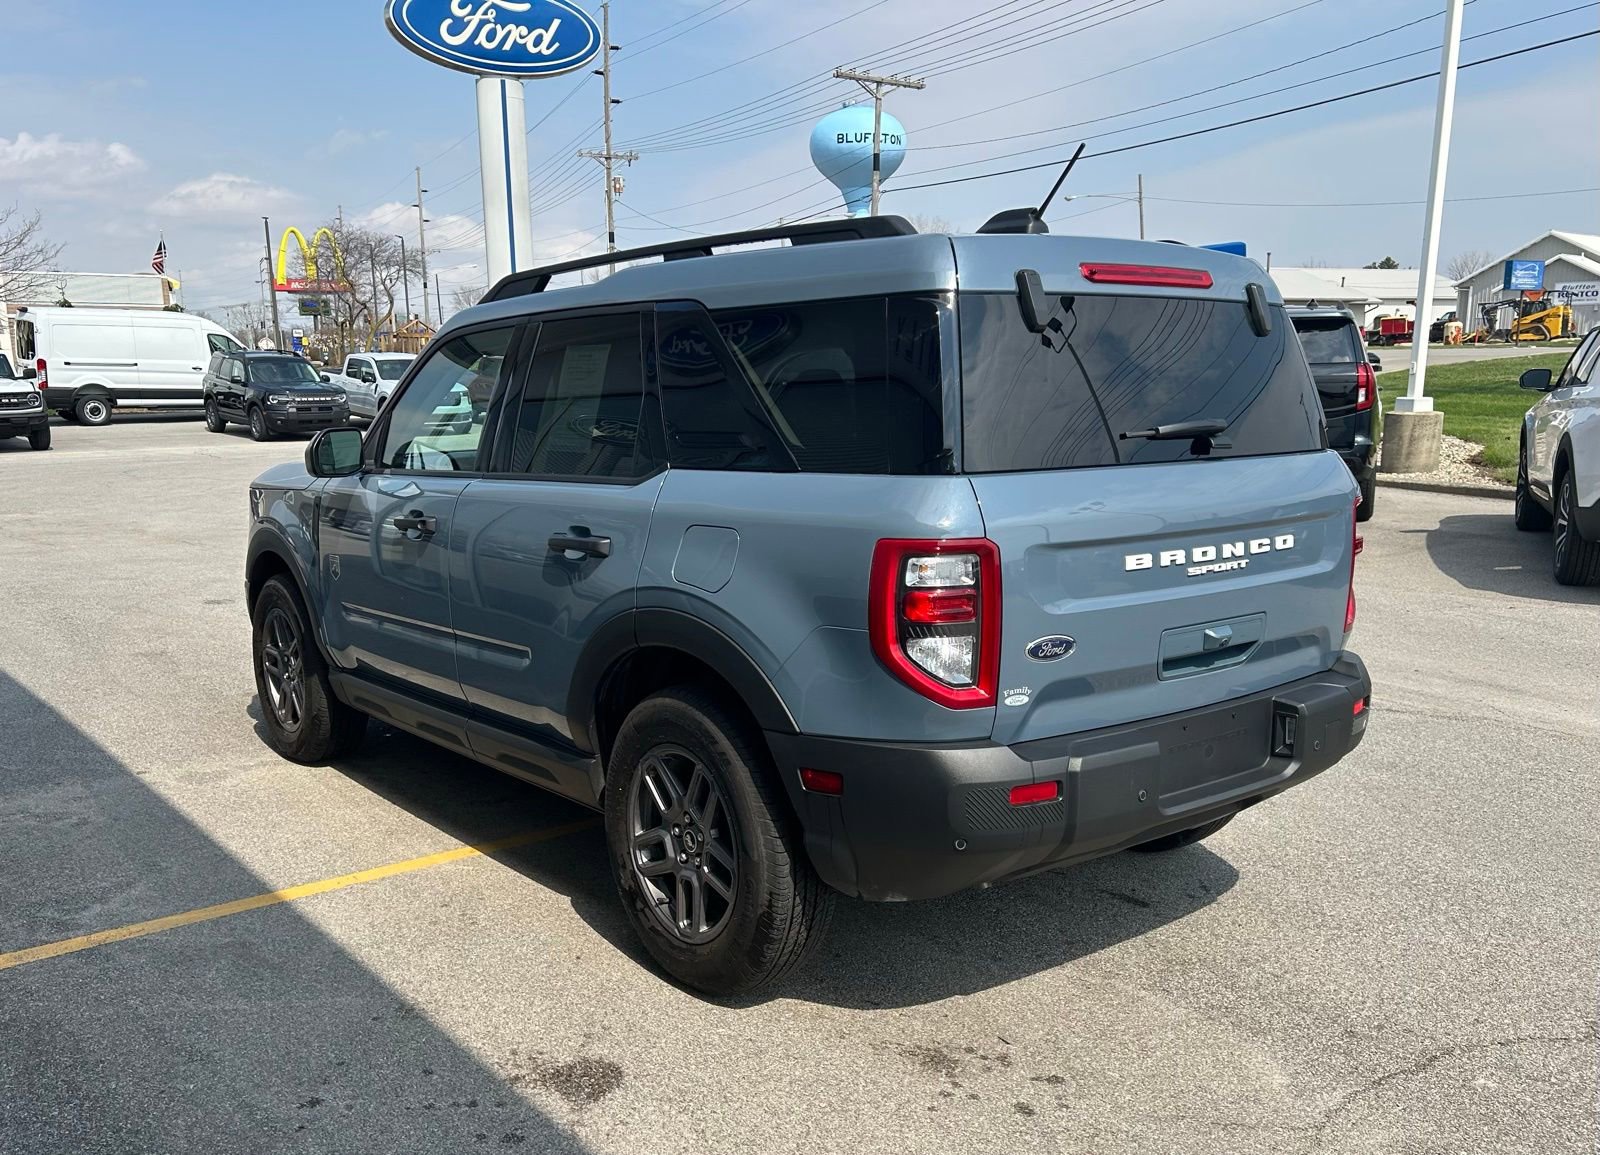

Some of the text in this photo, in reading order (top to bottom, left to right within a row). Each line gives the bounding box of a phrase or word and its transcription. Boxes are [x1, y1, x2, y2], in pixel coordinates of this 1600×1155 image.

[440, 0, 562, 55] Ford
[837, 132, 902, 145] BLUFTON
[1125, 534, 1295, 572] BRONCO
[1187, 559, 1250, 577] SPORT
[1038, 640, 1067, 657] Ford
[1003, 686, 1032, 698] Family
